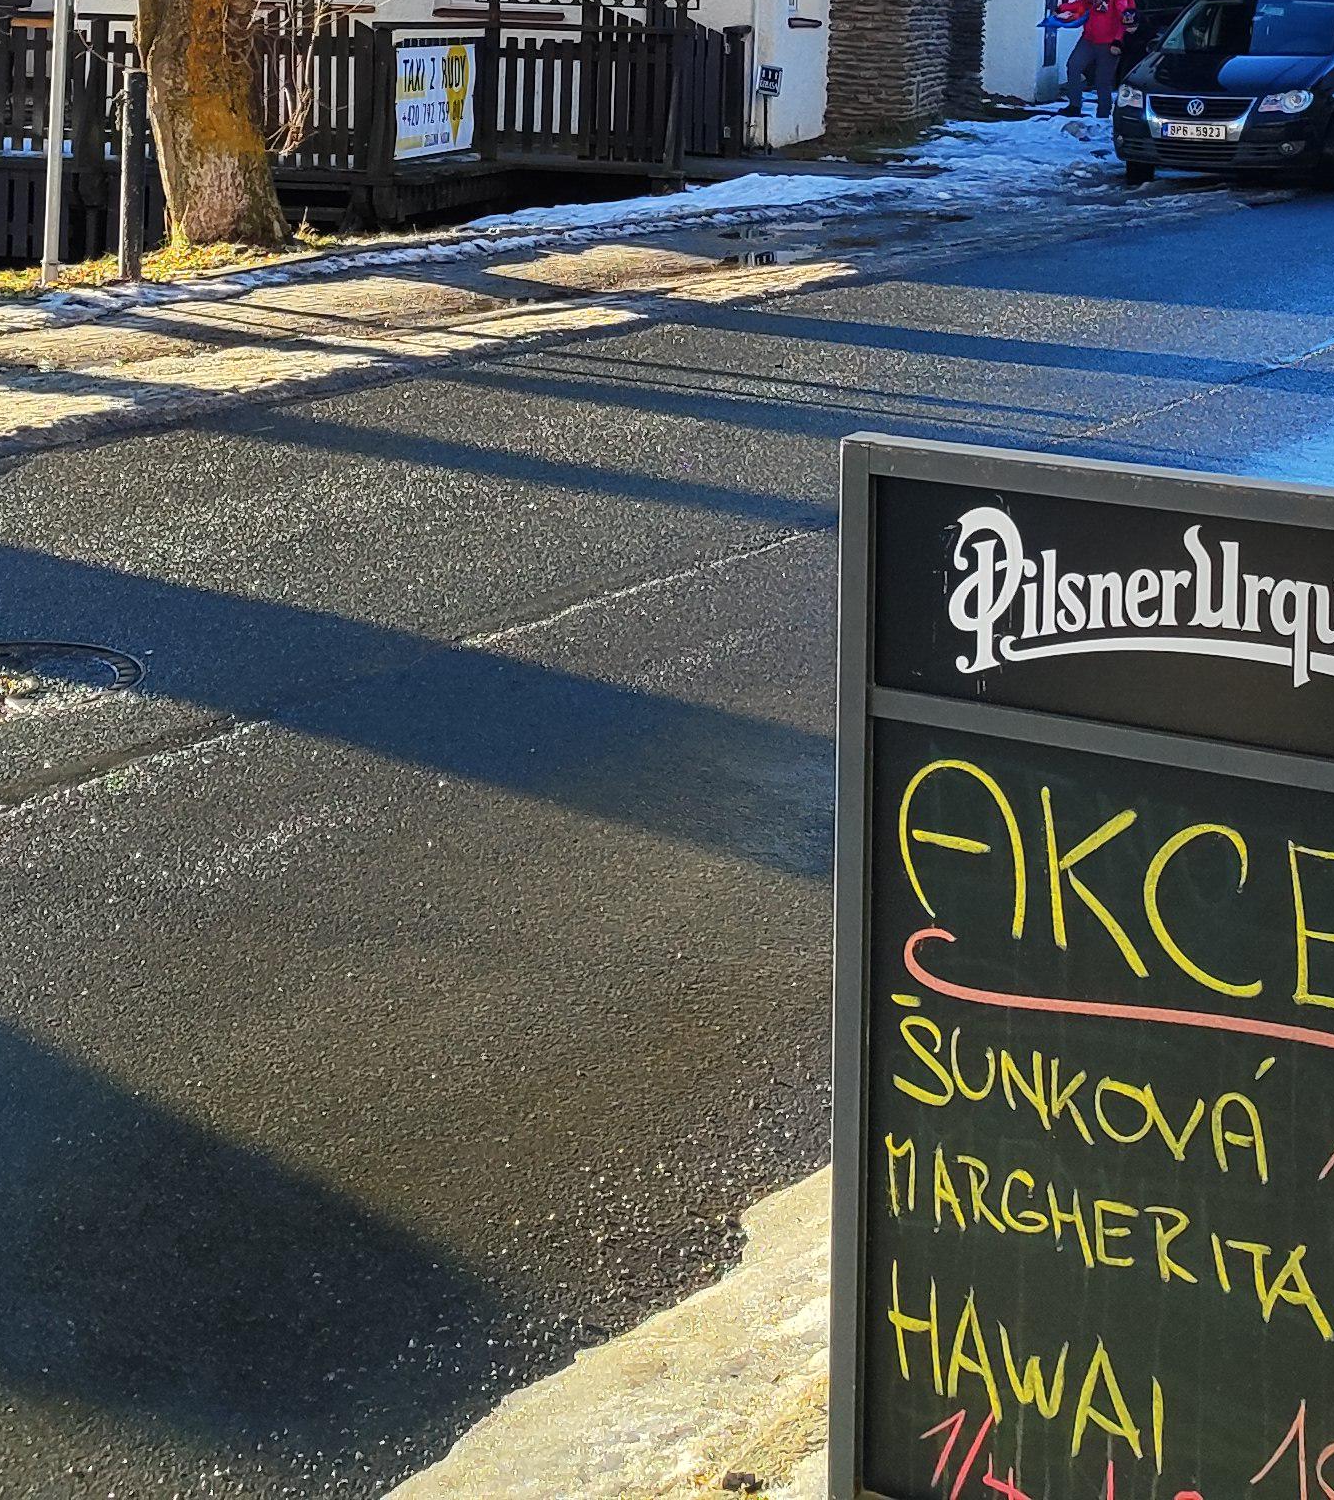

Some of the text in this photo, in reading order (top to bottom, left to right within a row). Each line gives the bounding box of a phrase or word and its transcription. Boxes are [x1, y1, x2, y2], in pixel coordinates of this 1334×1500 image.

[402, 57, 427, 93] TAXI
[441, 54, 467, 90] RUDY
[948, 505, 1193, 674] Pilsner
[890, 993, 1277, 1186] ŠUNKOVÁ
[886, 1256, 1165, 1476] HAWAI
